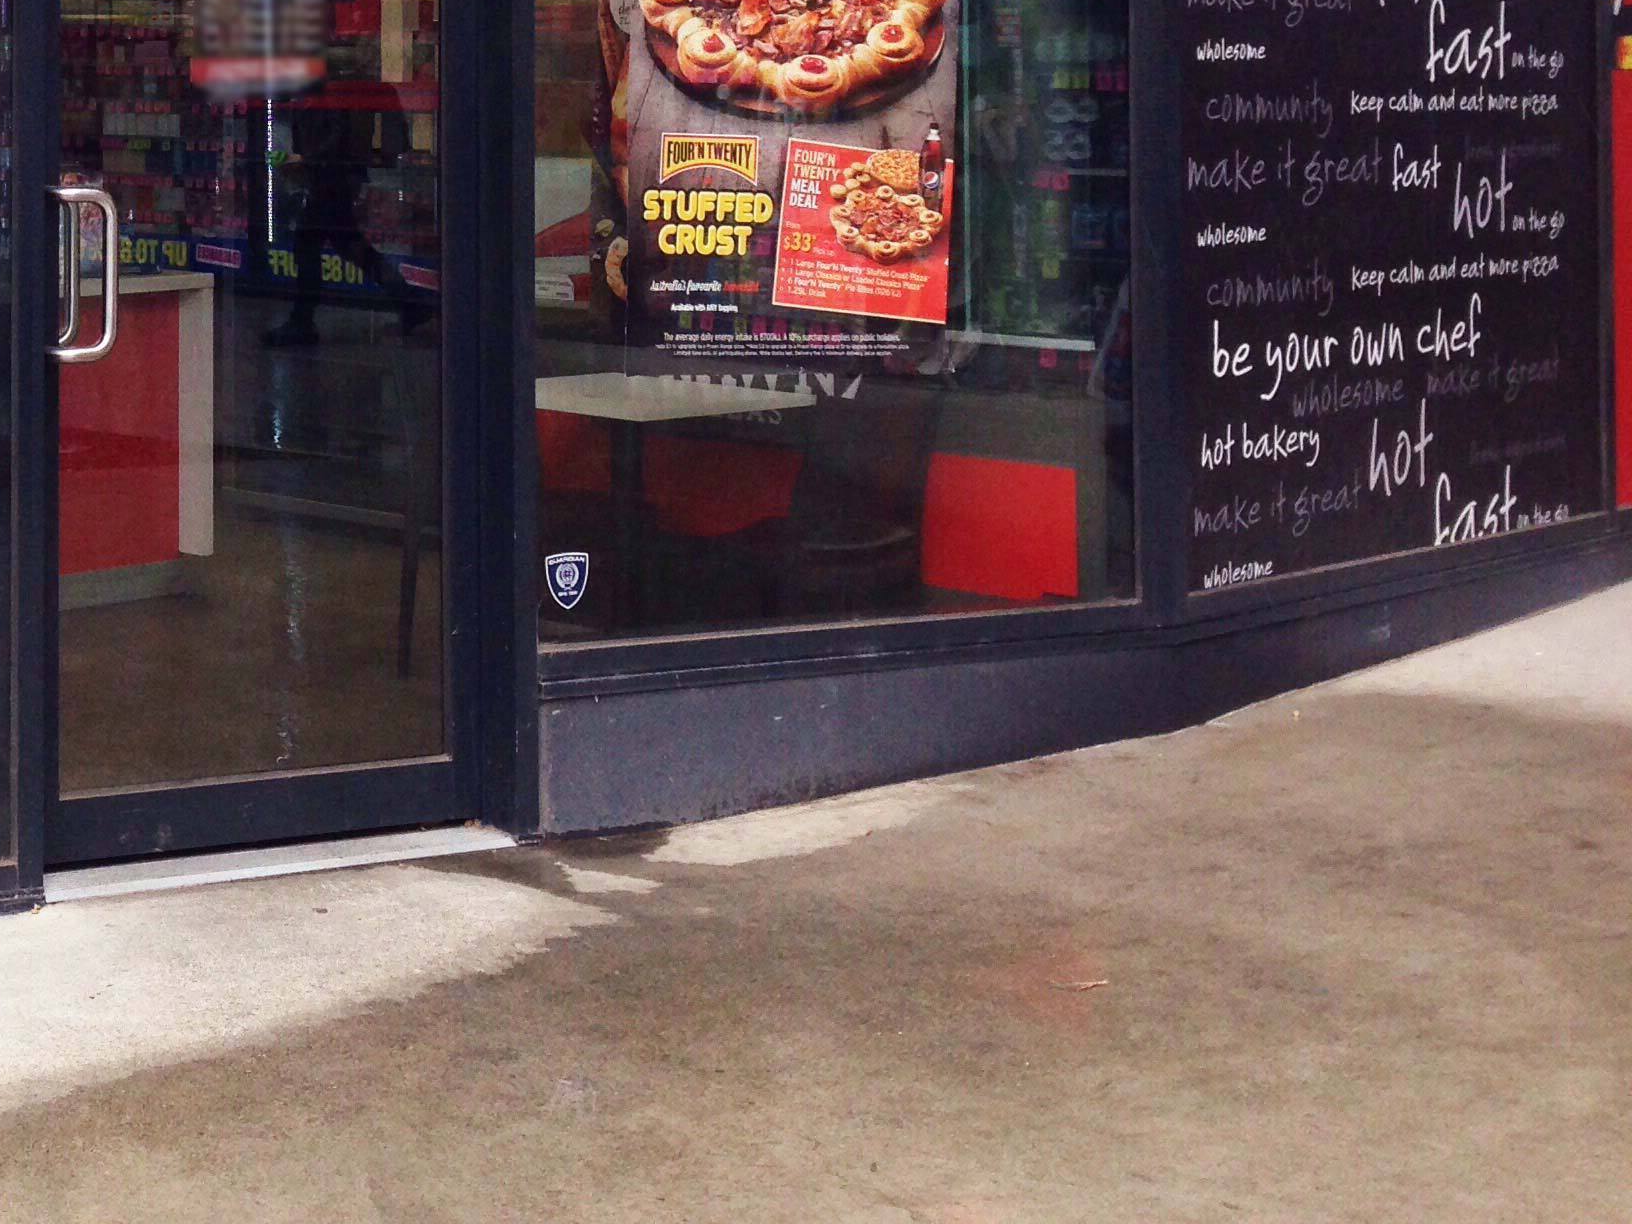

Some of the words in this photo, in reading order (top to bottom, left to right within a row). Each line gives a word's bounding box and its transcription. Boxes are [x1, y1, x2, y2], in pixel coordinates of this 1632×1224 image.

[1196, 37, 1267, 63] wholesome
[1527, 45, 1547, 70] the
[1205, 80, 1334, 139] community
[1388, 87, 1425, 114] calm
[1427, 86, 1456, 112] and
[1459, 85, 1485, 112] eat
[1487, 91, 1519, 112] more
[1521, 89, 1558, 120] pizza
[667, 140, 705, 169] FOUR'N
[706, 141, 753, 169] TWENTY
[794, 148, 836, 166] FOUR'N
[791, 178, 822, 195] MEAL
[793, 163, 840, 181] TWENTY
[1186, 149, 1266, 194] make
[1277, 138, 1295, 192] it
[1300, 135, 1383, 208] great
[1392, 142, 1442, 193] fast
[642, 189, 774, 223] STUFFED
[789, 193, 818, 209] DEAL
[1453, 147, 1514, 239] hot
[1528, 207, 1548, 232] the
[658, 224, 753, 256] CRUST
[1197, 222, 1268, 249] wholesome
[1206, 253, 1335, 317] community
[1389, 259, 1425, 285] calm
[1428, 255, 1457, 281] and
[1459, 252, 1485, 279] eat
[1487, 255, 1520, 276] more
[1521, 253, 1560, 284] pizza
[664, 332, 674, 341] The
[675, 333, 700, 343] average
[700, 332, 714, 342] daily
[714, 333, 734, 343] energy
[1212, 319, 1253, 378] be
[1260, 332, 1339, 400] your
[1350, 322, 1405, 367] own
[1416, 292, 1482, 361] chef
[1292, 375, 1407, 418] wholesome
[1200, 423, 1235, 471] hot
[1241, 422, 1320, 467] bakery
[1368, 397, 1434, 498] hot
[1193, 494, 1262, 538] make
[1293, 468, 1363, 538] great
[1434, 464, 1517, 546] fast
[1203, 558, 1274, 590] wholesome
